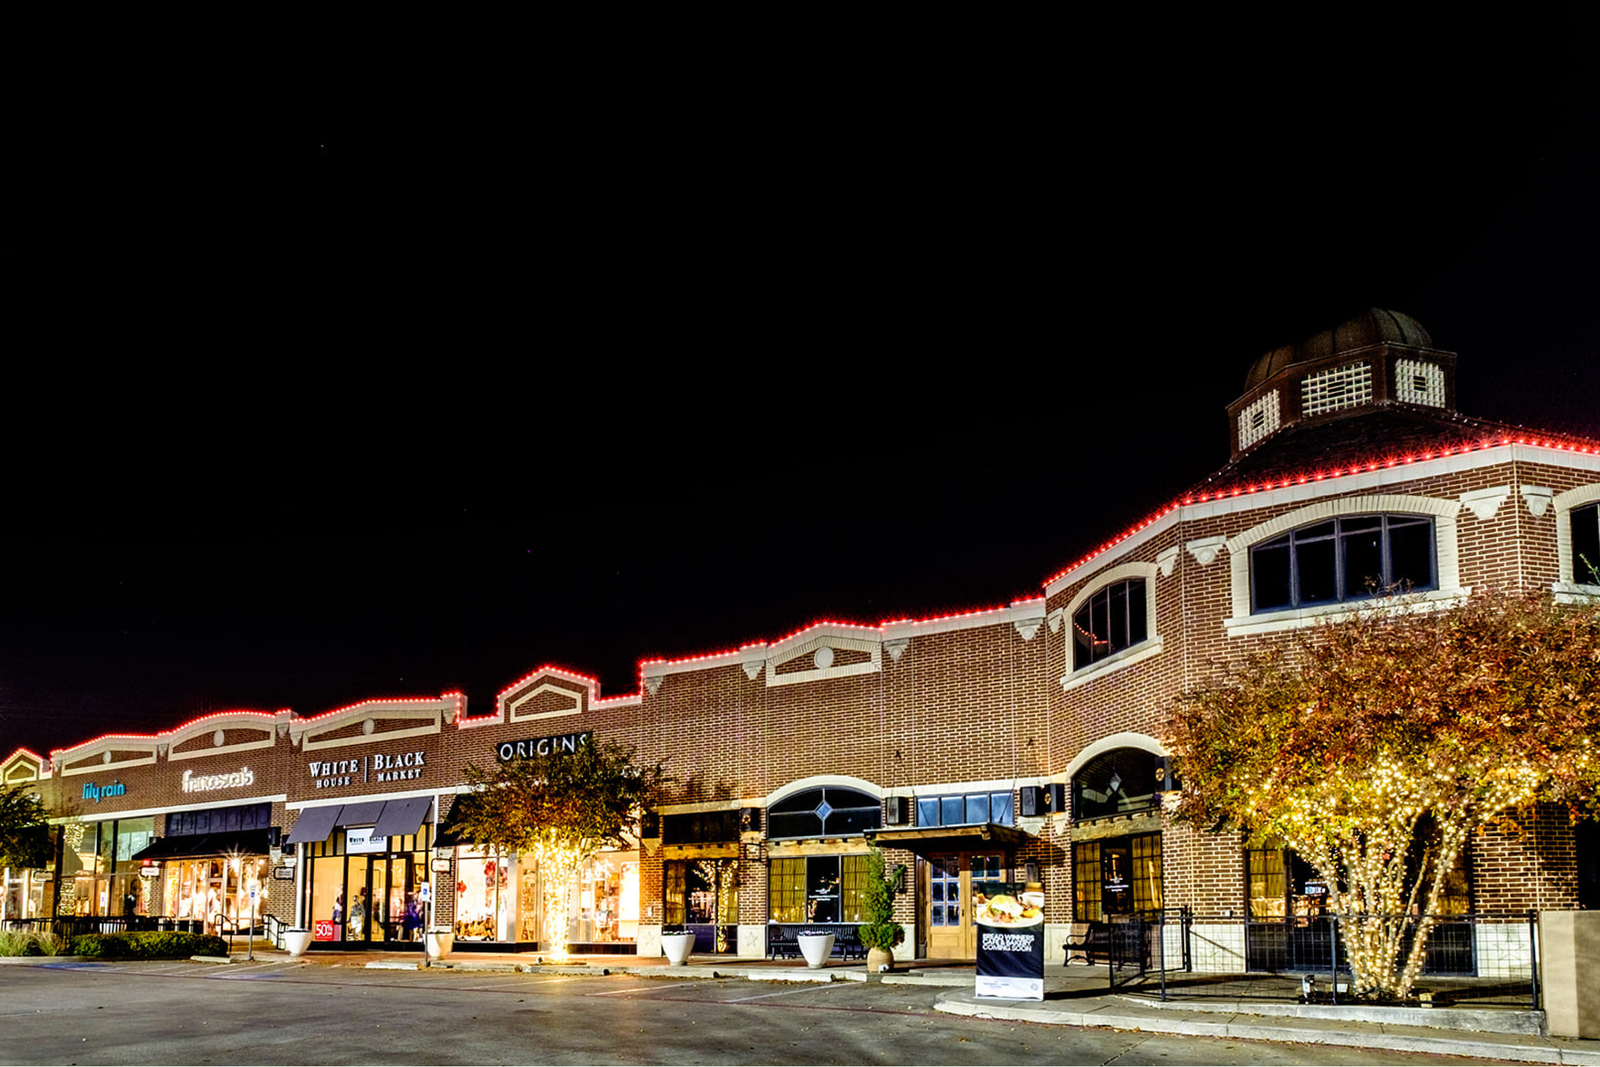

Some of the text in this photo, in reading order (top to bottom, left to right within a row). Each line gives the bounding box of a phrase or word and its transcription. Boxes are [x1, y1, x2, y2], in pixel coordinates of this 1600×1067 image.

[309, 759, 359, 777] WHITE
[374, 751, 425, 770] BLACK
[181, 766, 254, 793] francesca's
[316, 776, 351, 788] HOUSE
[377, 769, 422, 782] MARKET
[82, 779, 126, 803] lily rain
